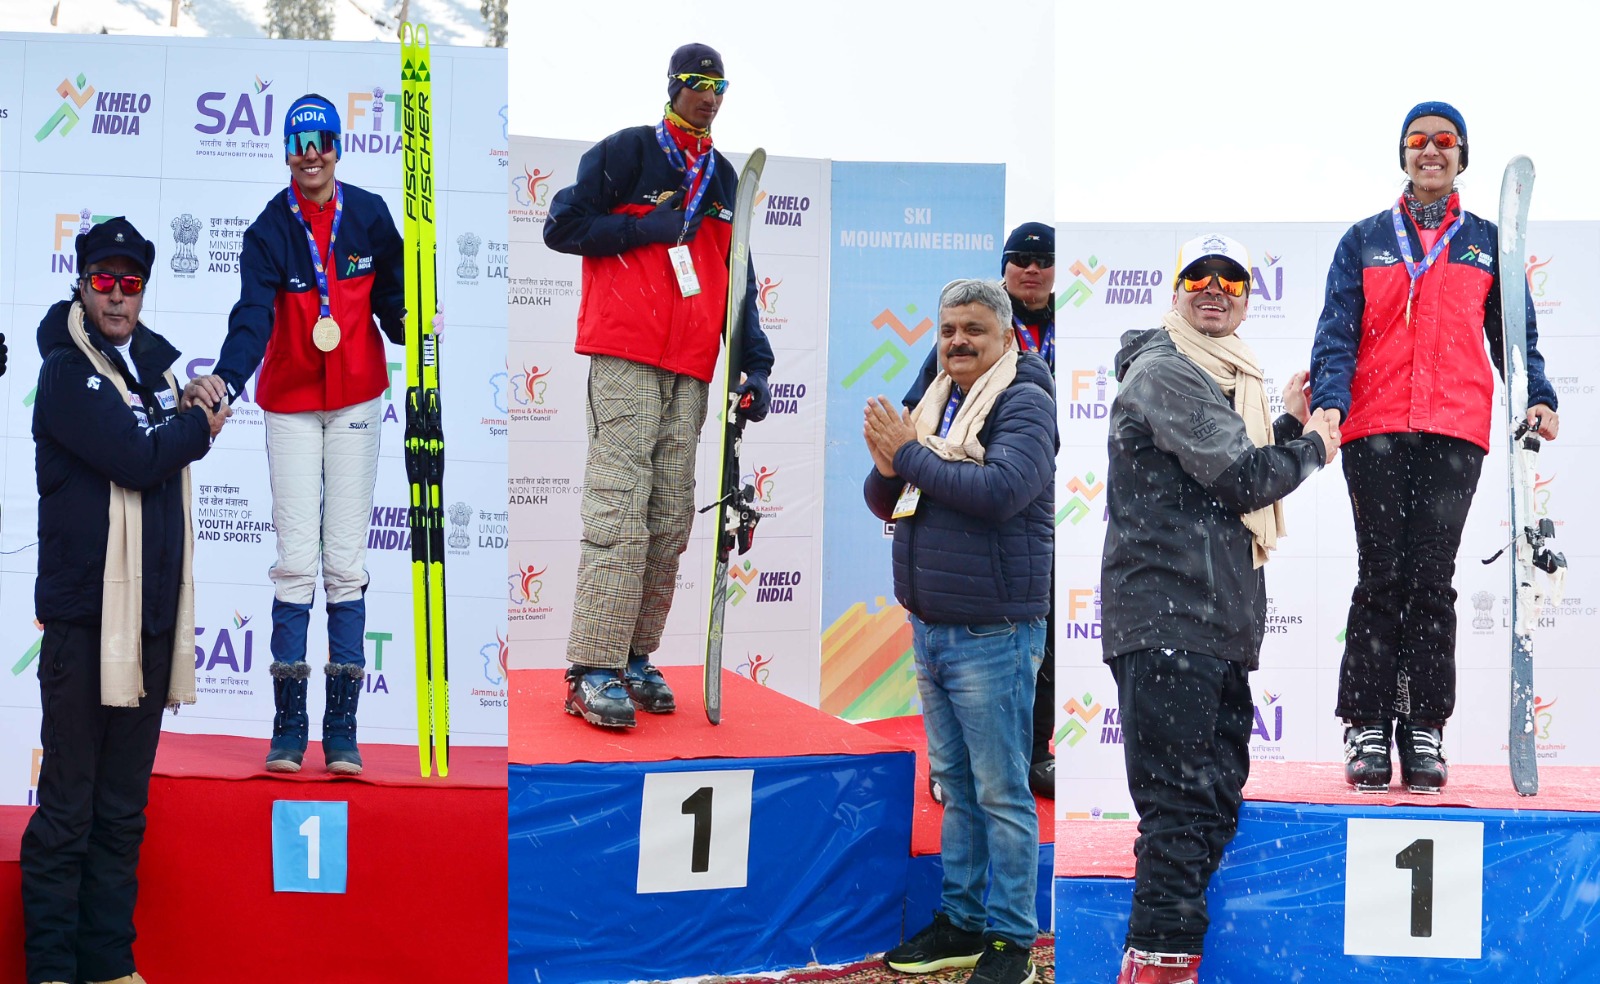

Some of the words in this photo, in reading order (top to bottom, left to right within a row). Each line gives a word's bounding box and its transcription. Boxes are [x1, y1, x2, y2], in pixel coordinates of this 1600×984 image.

[95, 91, 151, 114] KHELO
[194, 91, 273, 136] SAI
[291, 110, 327, 126] INDIA
[91, 114, 140, 136] INDIA
[404, 89, 417, 222] FISCHER
[418, 91, 433, 225] FISCHER
[767, 195, 810, 212] KHELO
[764, 210, 802, 226] INDIA
[904, 207, 932, 225] SKI
[209, 240, 243, 250] MINISTR
[840, 230, 994, 251] MOUNTAINEERING
[208, 262, 230, 273] AND
[1108, 270, 1162, 286] KHELO
[1250, 266, 1283, 301] AI
[535, 288, 574, 296] TERRITORY
[1105, 288, 1152, 304] INDIA
[769, 400, 798, 414] NDIA
[1070, 404, 1108, 419] IND
[490, 427, 508, 436] Sport
[532, 486, 571, 494] TERRITORY
[508, 495, 548, 505] ADAKH
[198, 508, 238, 518] MINISTRY
[240, 510, 252, 519] OF
[198, 519, 233, 530] YOUTH
[236, 521, 276, 532] AFFAIRS
[198, 530, 220, 541] AND
[224, 532, 262, 544] SPORTS
[759, 571, 801, 586] KHELO
[756, 587, 793, 602] INDIA
[1541, 608, 1583, 616] ERRITORY
[1586, 608, 1598, 616] OF
[1067, 622, 1102, 639] IND
[471, 688, 498, 697] Jammu
[480, 698, 502, 708] Sports
[1252, 706, 1282, 742] AI
[682, 786, 714, 873] 1
[299, 815, 320, 880] 1
[1396, 838, 1434, 938] 1
